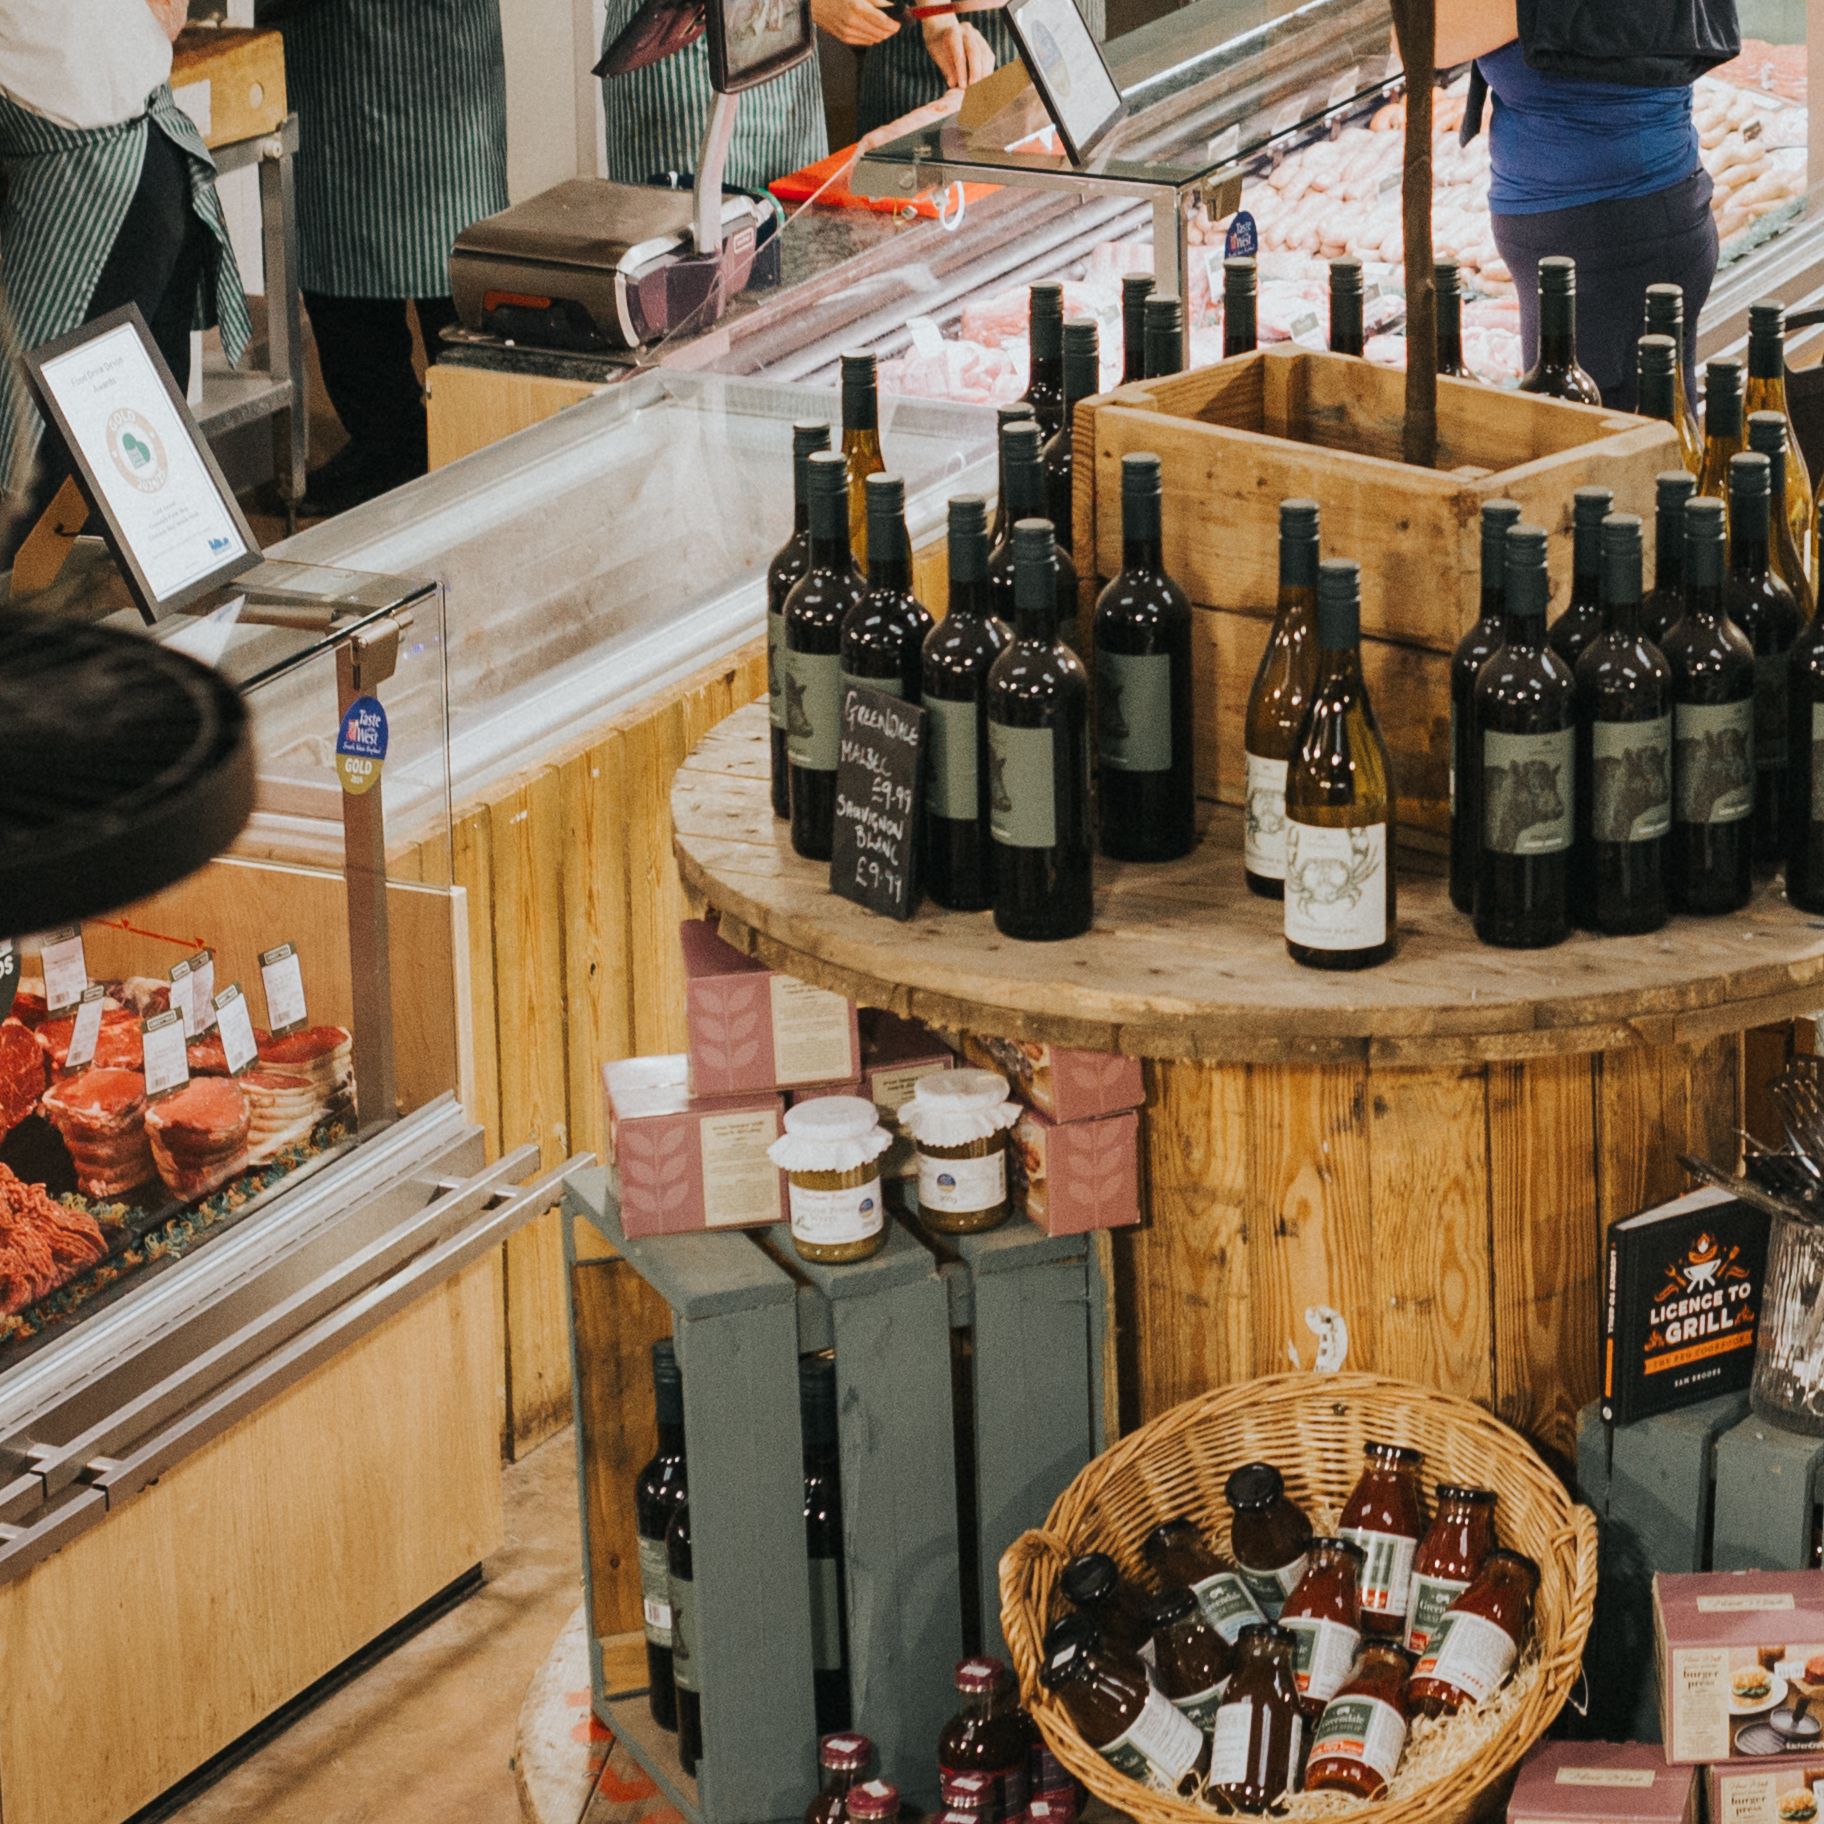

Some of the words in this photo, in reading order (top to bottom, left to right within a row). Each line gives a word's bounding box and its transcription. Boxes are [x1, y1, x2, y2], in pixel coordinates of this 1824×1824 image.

[109, 410, 137, 430] GOLD
[360, 709, 381, 728] Taste
[357, 727, 379, 746] West
[345, 758, 372, 775] GOLD
[1650, 1289, 1723, 1325] LICENCE
[1728, 1282, 1752, 1302] TO
[1665, 1307, 1734, 1345] GRILL
[1683, 1669, 1719, 1681] burger
[1687, 1678, 1716, 1689] press
[1731, 1795, 1767, 1807] burger
